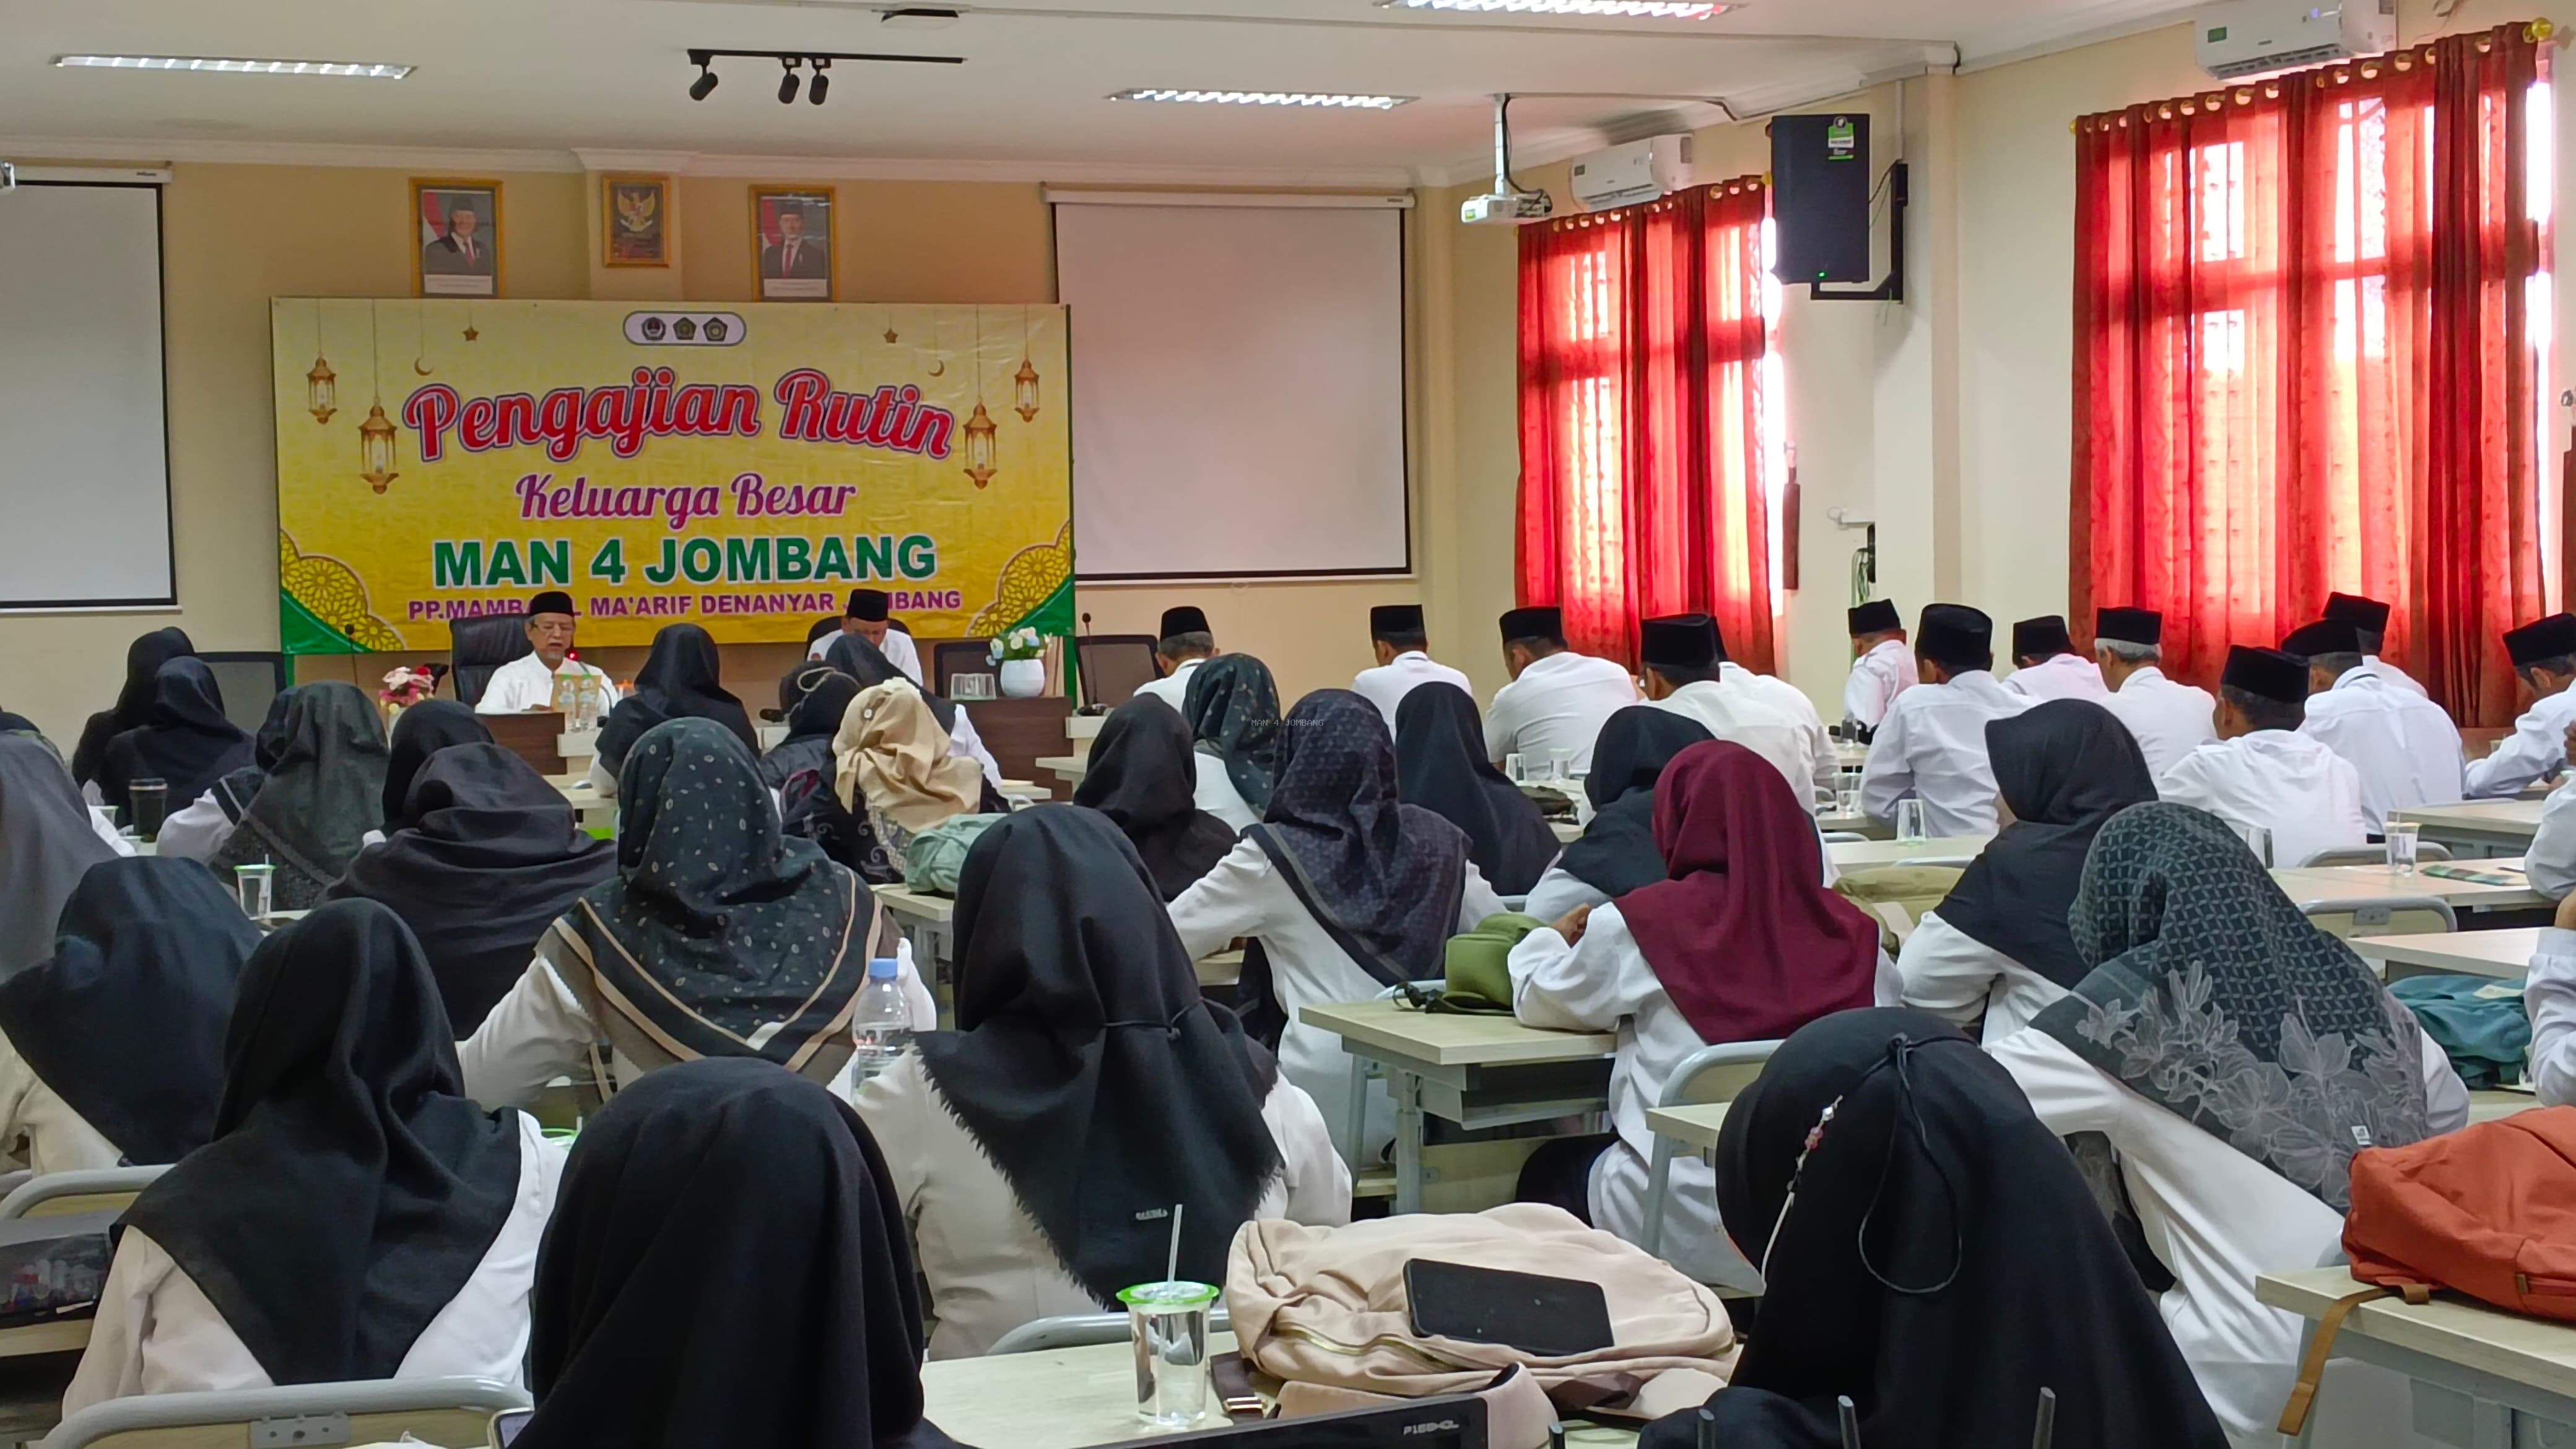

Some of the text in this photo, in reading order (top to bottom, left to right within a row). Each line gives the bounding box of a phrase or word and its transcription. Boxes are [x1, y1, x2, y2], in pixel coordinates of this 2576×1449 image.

[403, 367, 954, 462] Pengajian Rutin
[515, 472, 856, 530] Keluarga Besar
[434, 534, 936, 586] MAN 4 JOMBANG
[590, 595, 692, 617] MA'ARIF
[701, 593, 834, 614] DENANYAR
